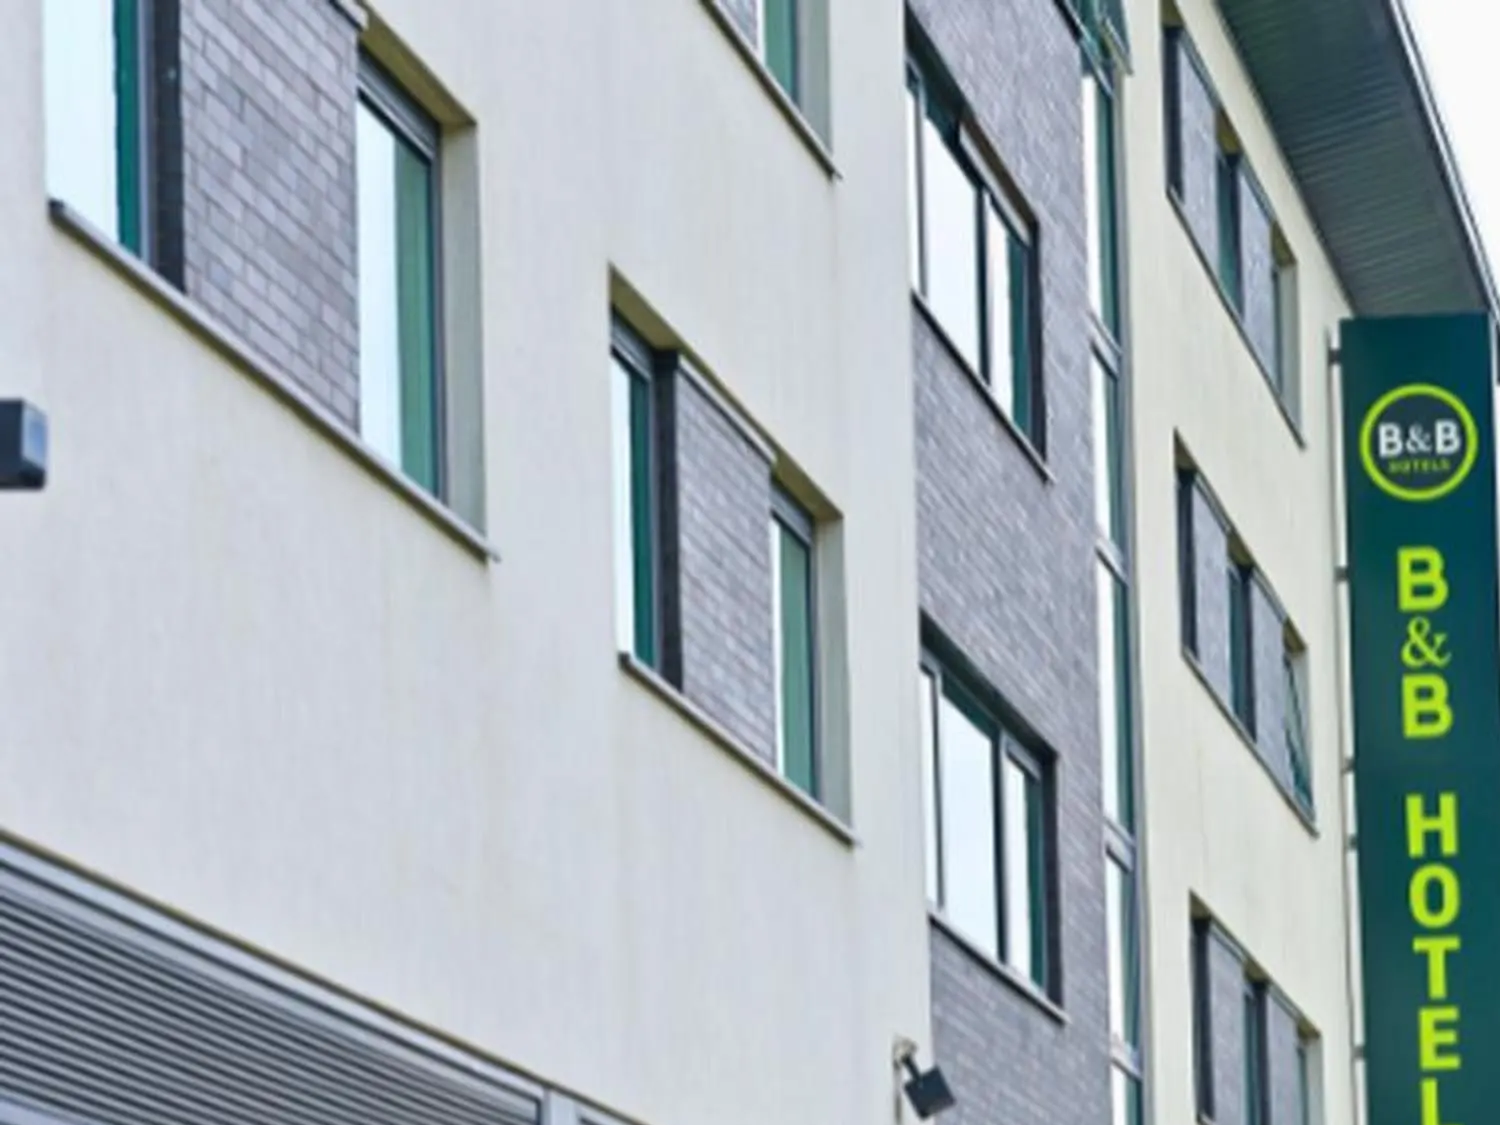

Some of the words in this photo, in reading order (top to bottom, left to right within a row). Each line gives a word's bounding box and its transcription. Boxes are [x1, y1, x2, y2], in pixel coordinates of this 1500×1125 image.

[1378, 420, 1461, 457] B&B
[1388, 458, 1451, 474] HOTELS
[1398, 547, 1453, 738] B&B
